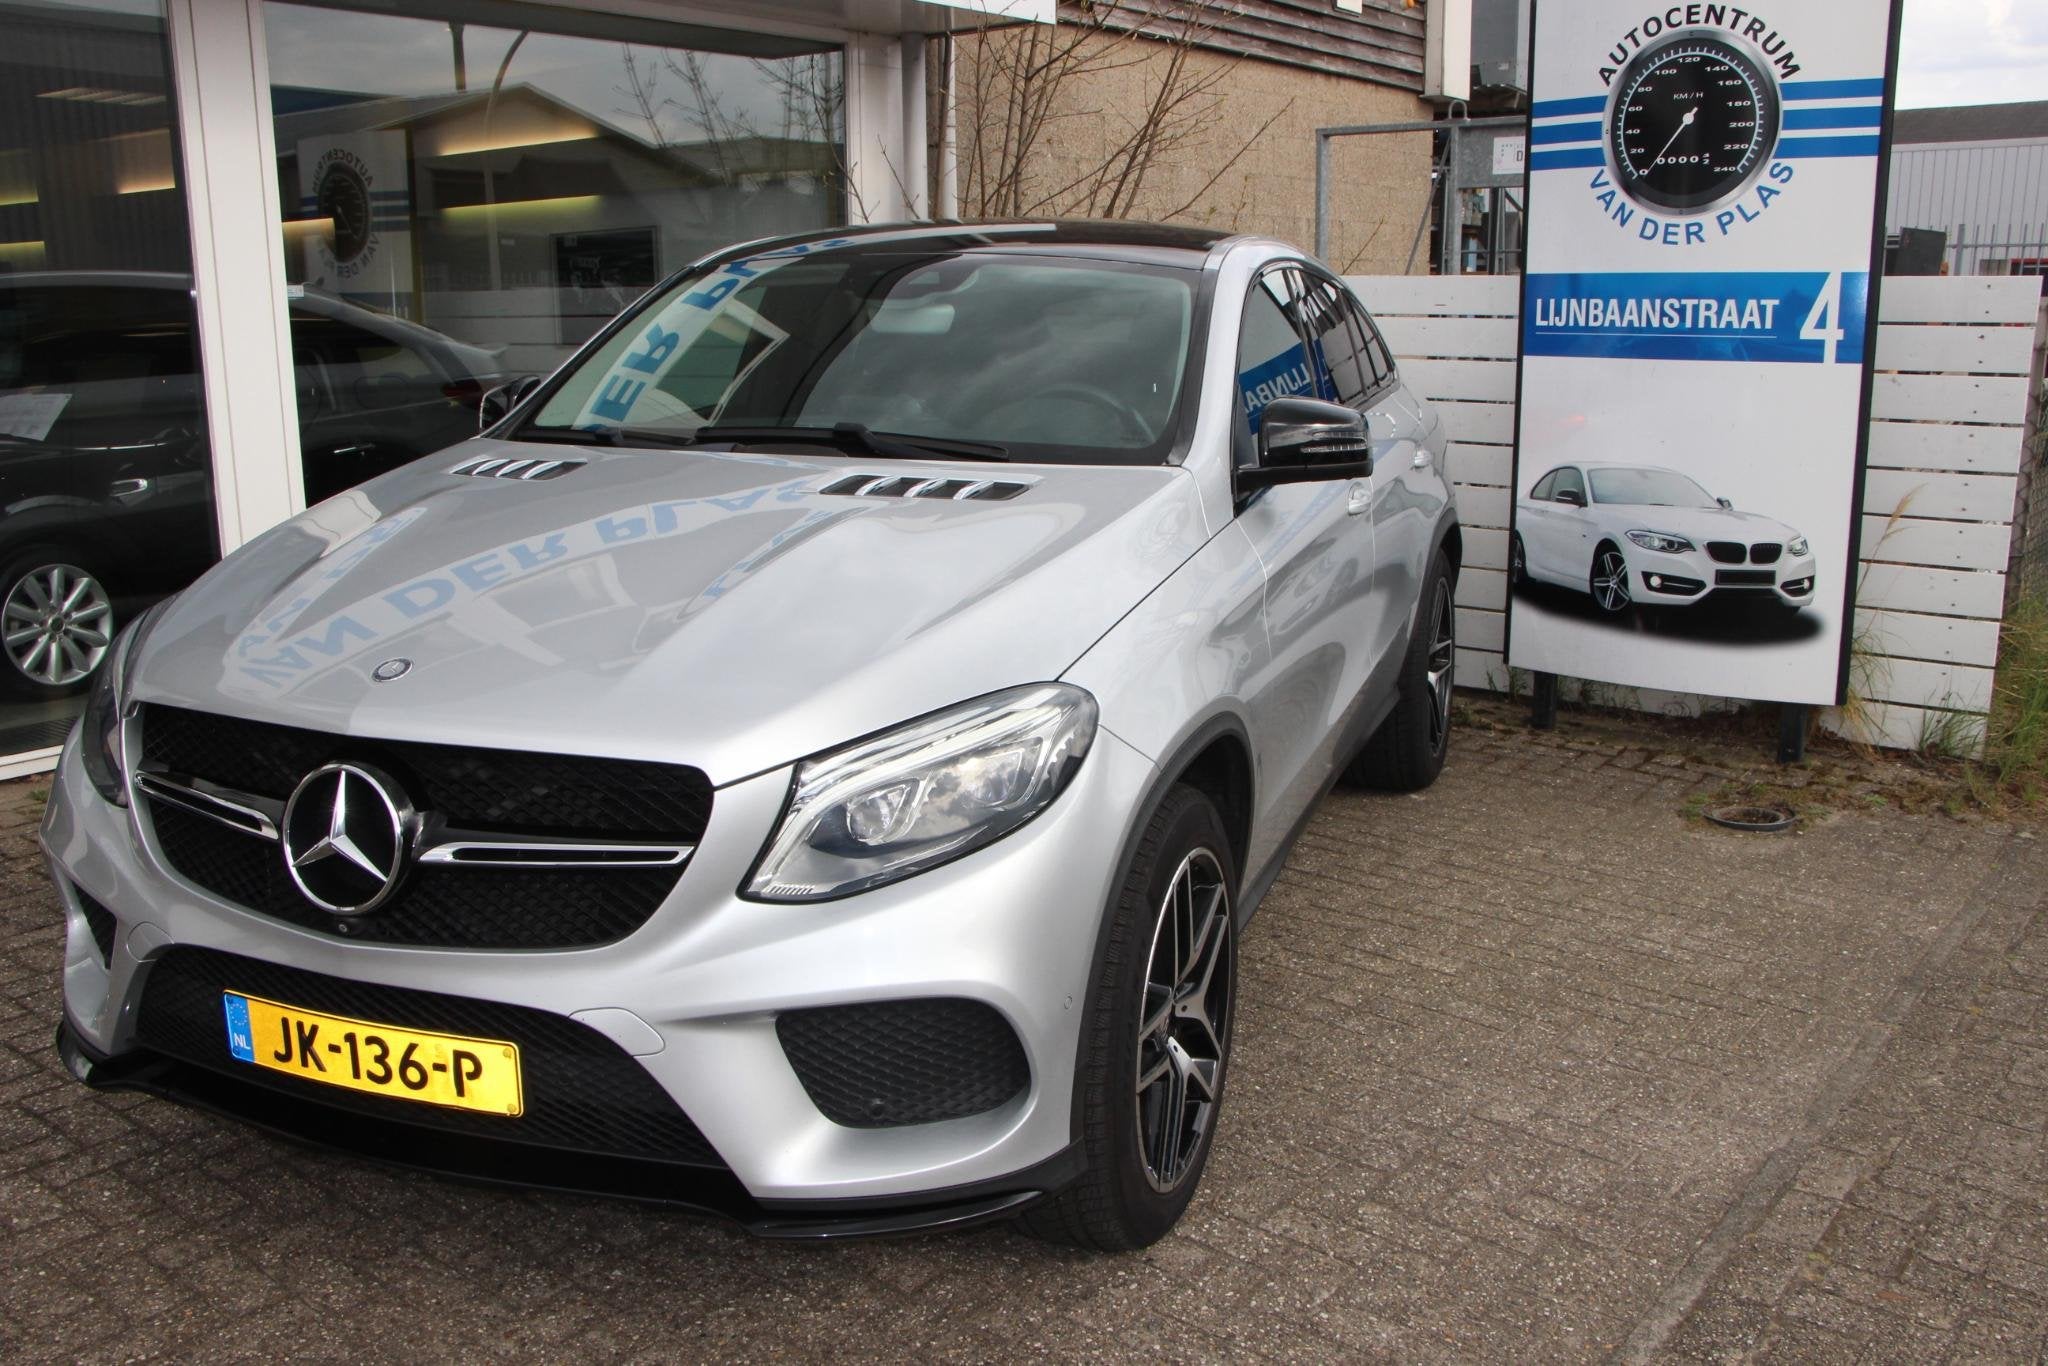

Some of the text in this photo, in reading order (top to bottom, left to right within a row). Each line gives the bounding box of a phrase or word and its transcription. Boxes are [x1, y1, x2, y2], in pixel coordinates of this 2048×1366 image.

[1599, 3, 1800, 87] AUTOCENTRUM
[1589, 162, 1794, 245] VAN DER PLAS
[1535, 271, 1844, 364] LIJNBAANSTRAAT 4
[234, 1032, 251, 1050] NL
[273, 1016, 483, 1098] JK-136-P
